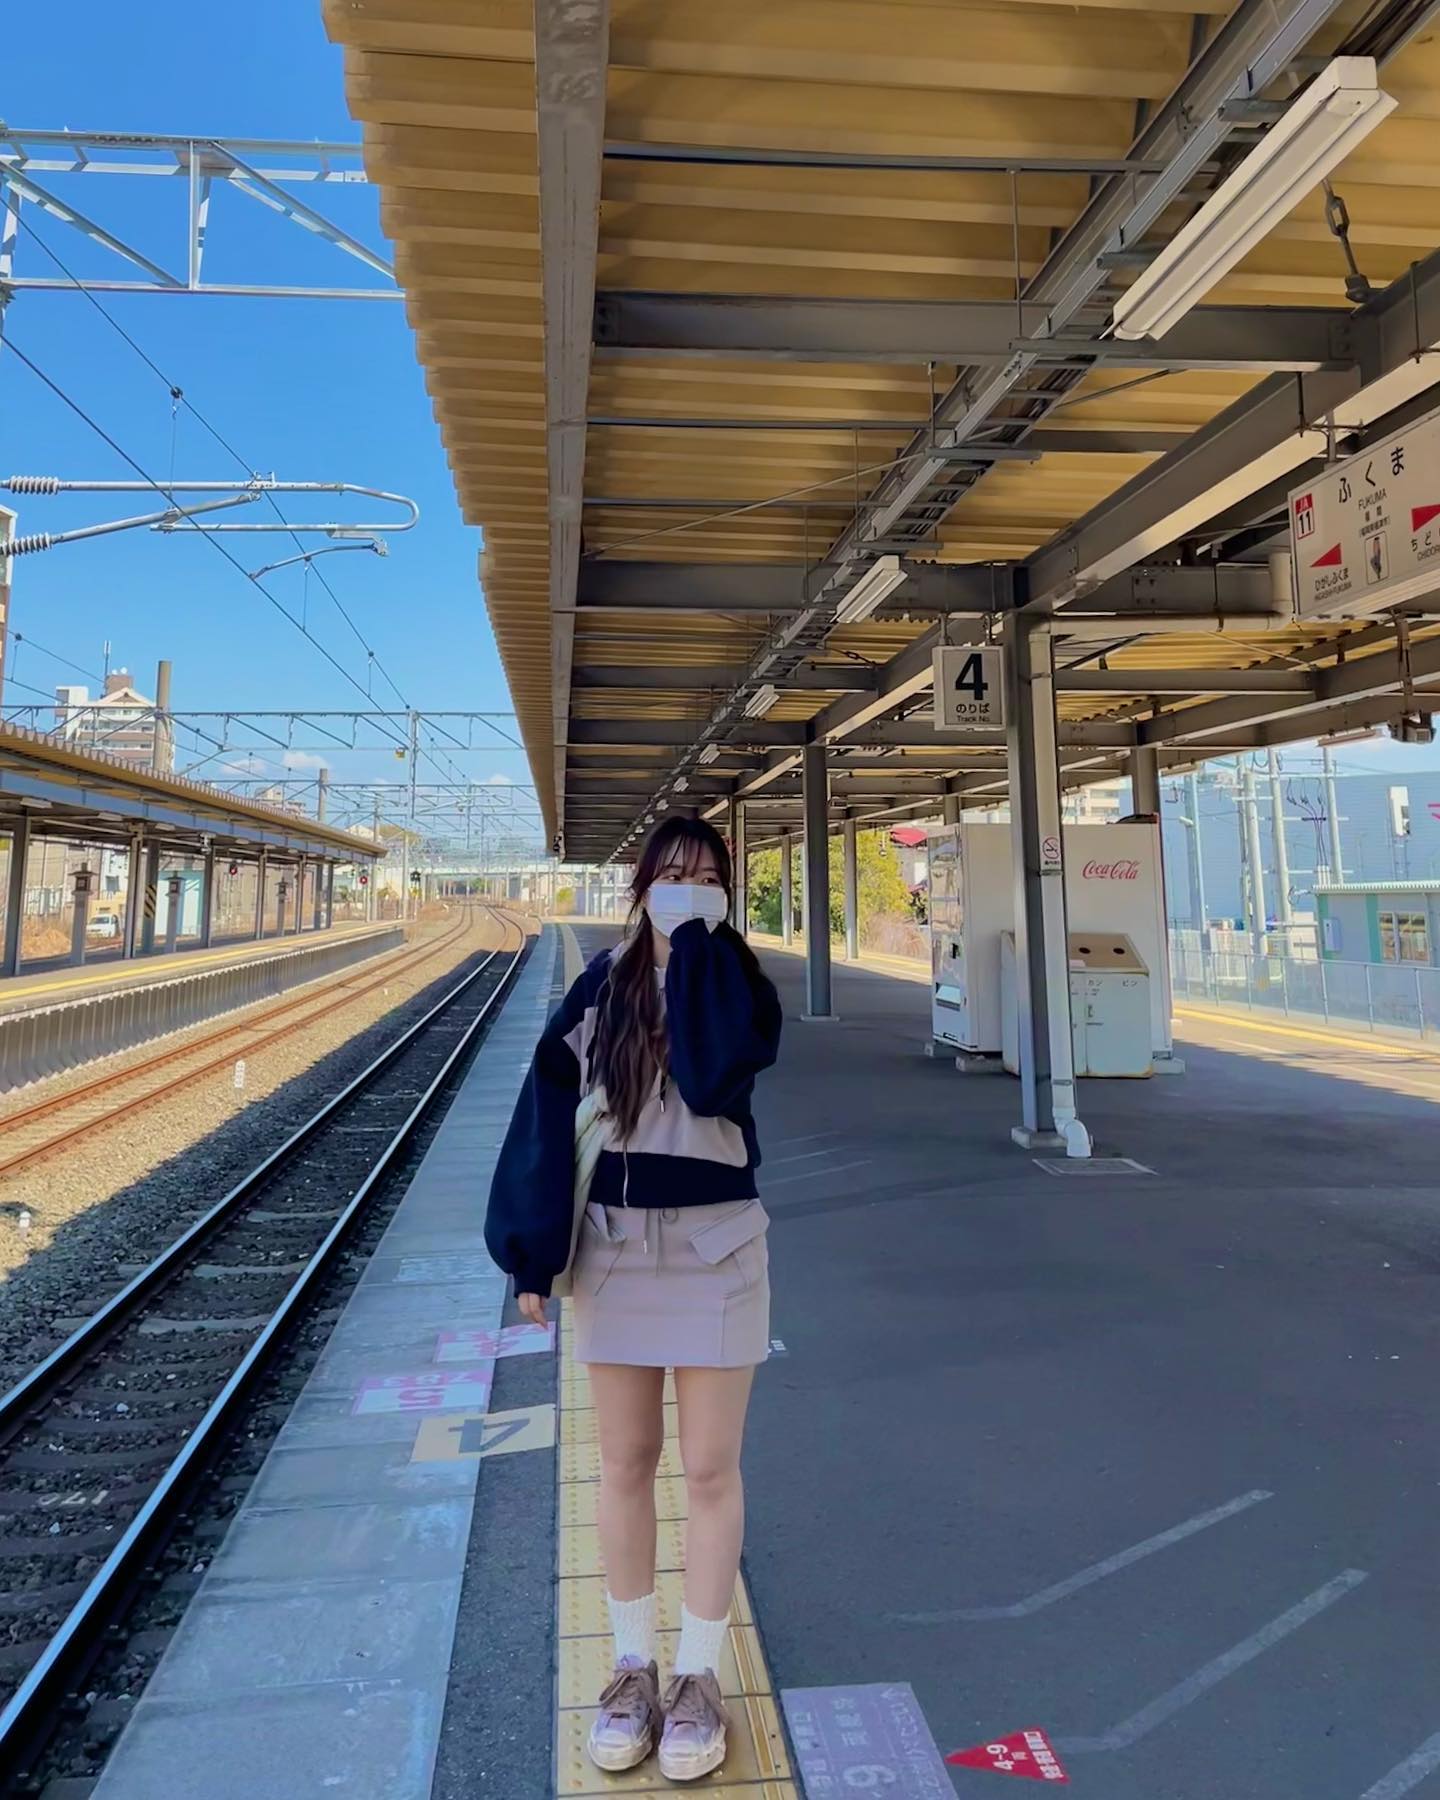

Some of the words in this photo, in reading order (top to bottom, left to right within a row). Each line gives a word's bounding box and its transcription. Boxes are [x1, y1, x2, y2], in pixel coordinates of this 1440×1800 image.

[1338, 447, 1404, 503] ふくま
[1300, 511, 1311, 534] 11
[1411, 530, 1440, 552] ちど
[955, 653, 988, 700] 4
[956, 703, 990, 714] のりば
[398, 1388, 446, 1408] 5
[448, 1418, 531, 1453] 4
[986, 1744, 1015, 1770] 4-9
